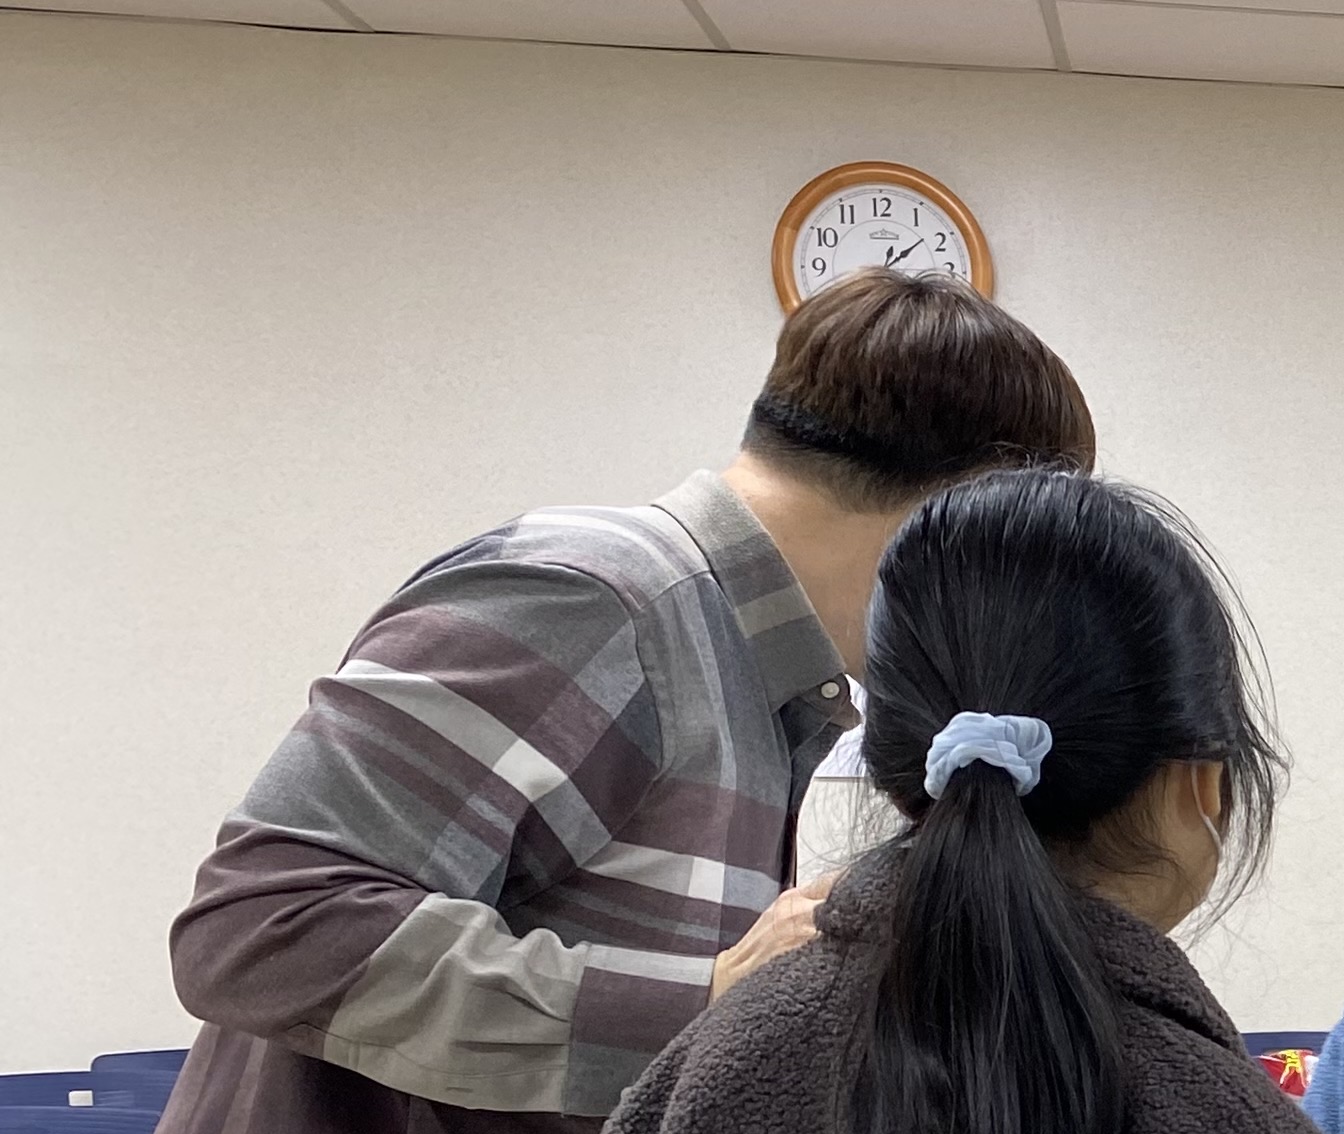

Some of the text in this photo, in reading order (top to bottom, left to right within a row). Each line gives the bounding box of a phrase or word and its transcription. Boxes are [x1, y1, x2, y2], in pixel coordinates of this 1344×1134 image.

[839, 203, 855, 225] 11
[873, 197, 892, 218] 12
[913, 207, 919, 227] 1
[816, 227, 838, 248] 10
[934, 232, 947, 252] 2
[812, 257, 826, 277] 9
